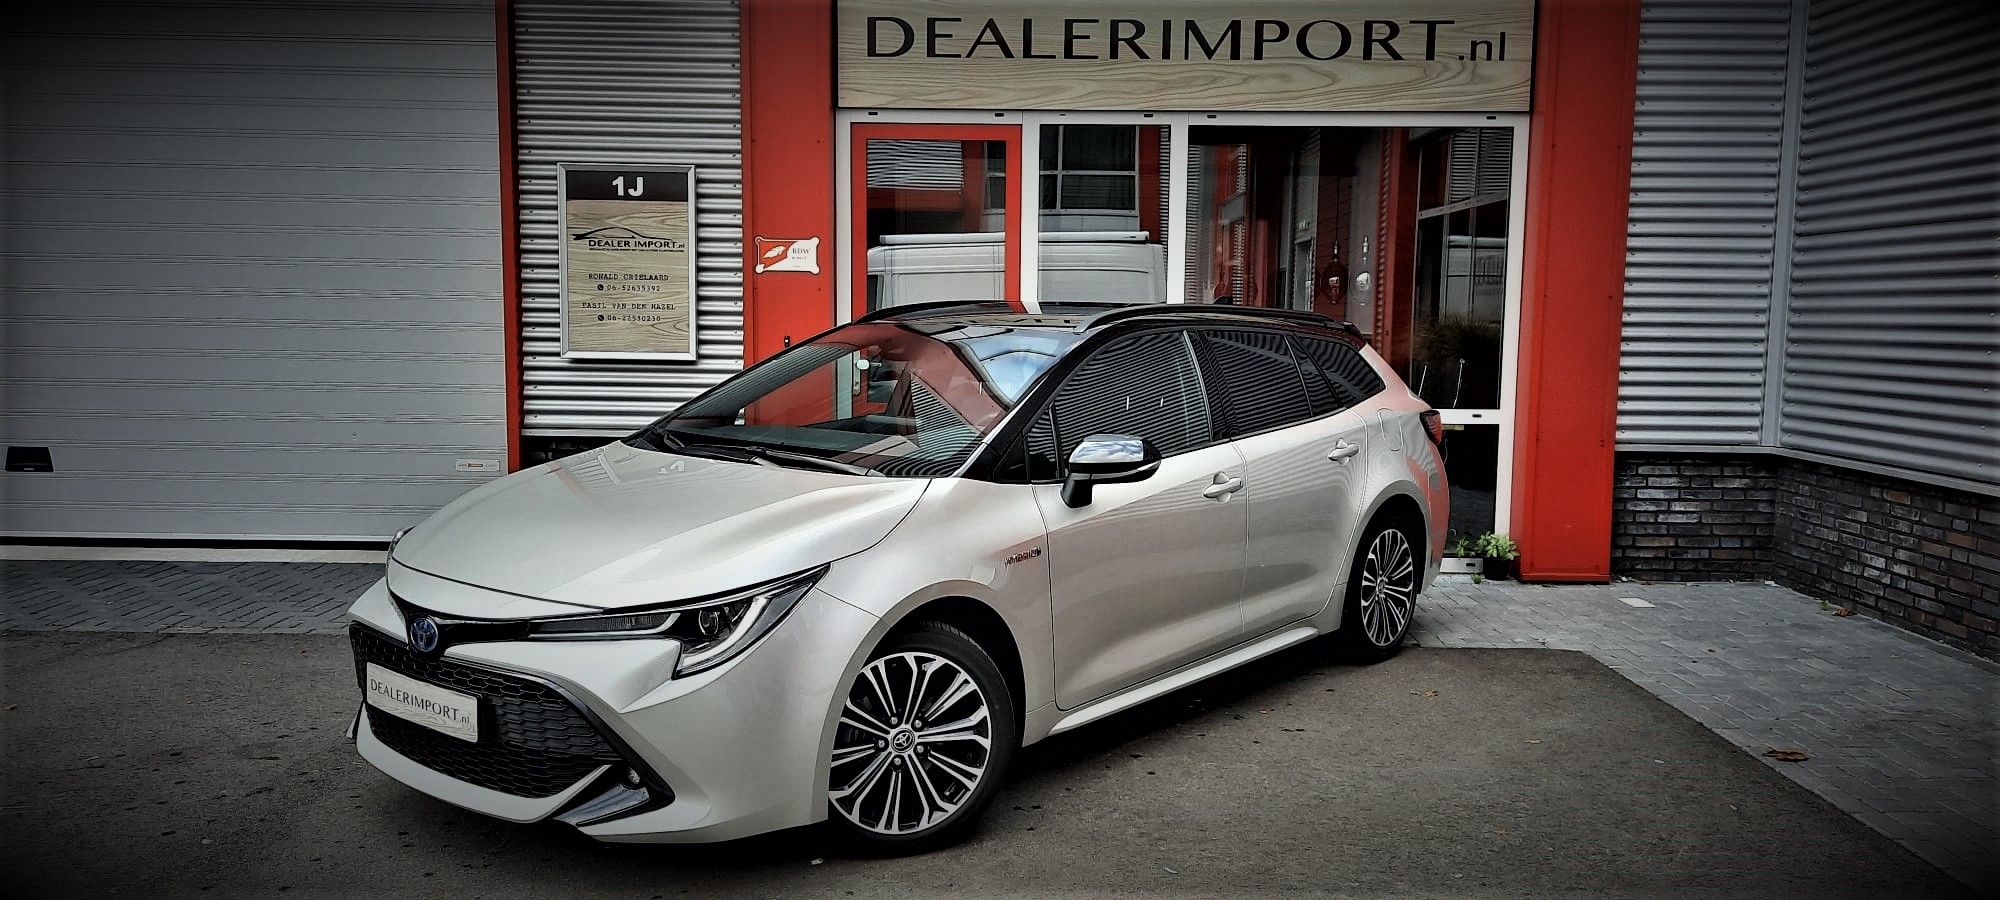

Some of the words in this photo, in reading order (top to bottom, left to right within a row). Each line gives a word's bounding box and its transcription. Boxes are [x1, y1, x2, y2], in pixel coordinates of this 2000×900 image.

[866, 16, 1507, 62] DEALERIMPORT.nl
[611, 175, 644, 197] 1J
[588, 239, 631, 248] DEALER
[588, 273, 619, 281] RONALD
[370, 678, 470, 724] DEALERIMPORT.nl
